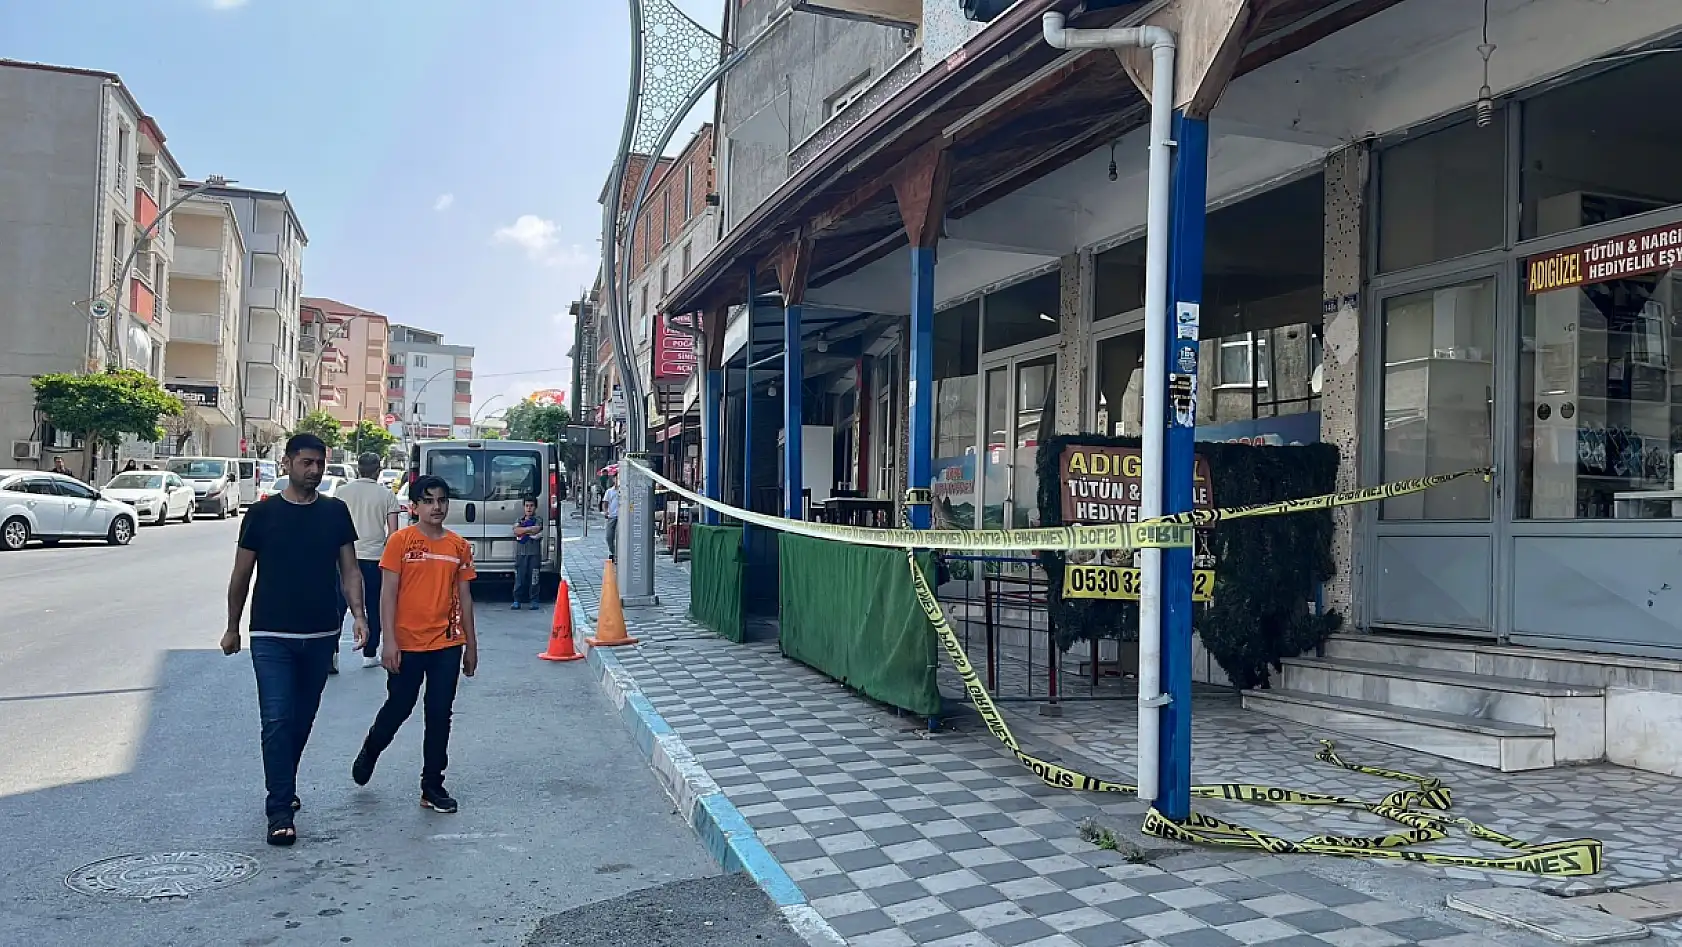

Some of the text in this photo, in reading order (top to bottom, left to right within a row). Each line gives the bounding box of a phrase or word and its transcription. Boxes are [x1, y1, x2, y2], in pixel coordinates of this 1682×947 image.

[1583, 240, 1624, 263] TÜTÜN
[1627, 239, 1638, 254] &
[1529, 253, 1583, 291] ADIGÜZEL
[1068, 452, 1205, 482] ADIGL
[1068, 477, 1124, 500] TÜTÜN
[1071, 568, 1120, 593] 0530
[1122, 570, 1142, 595] 32
